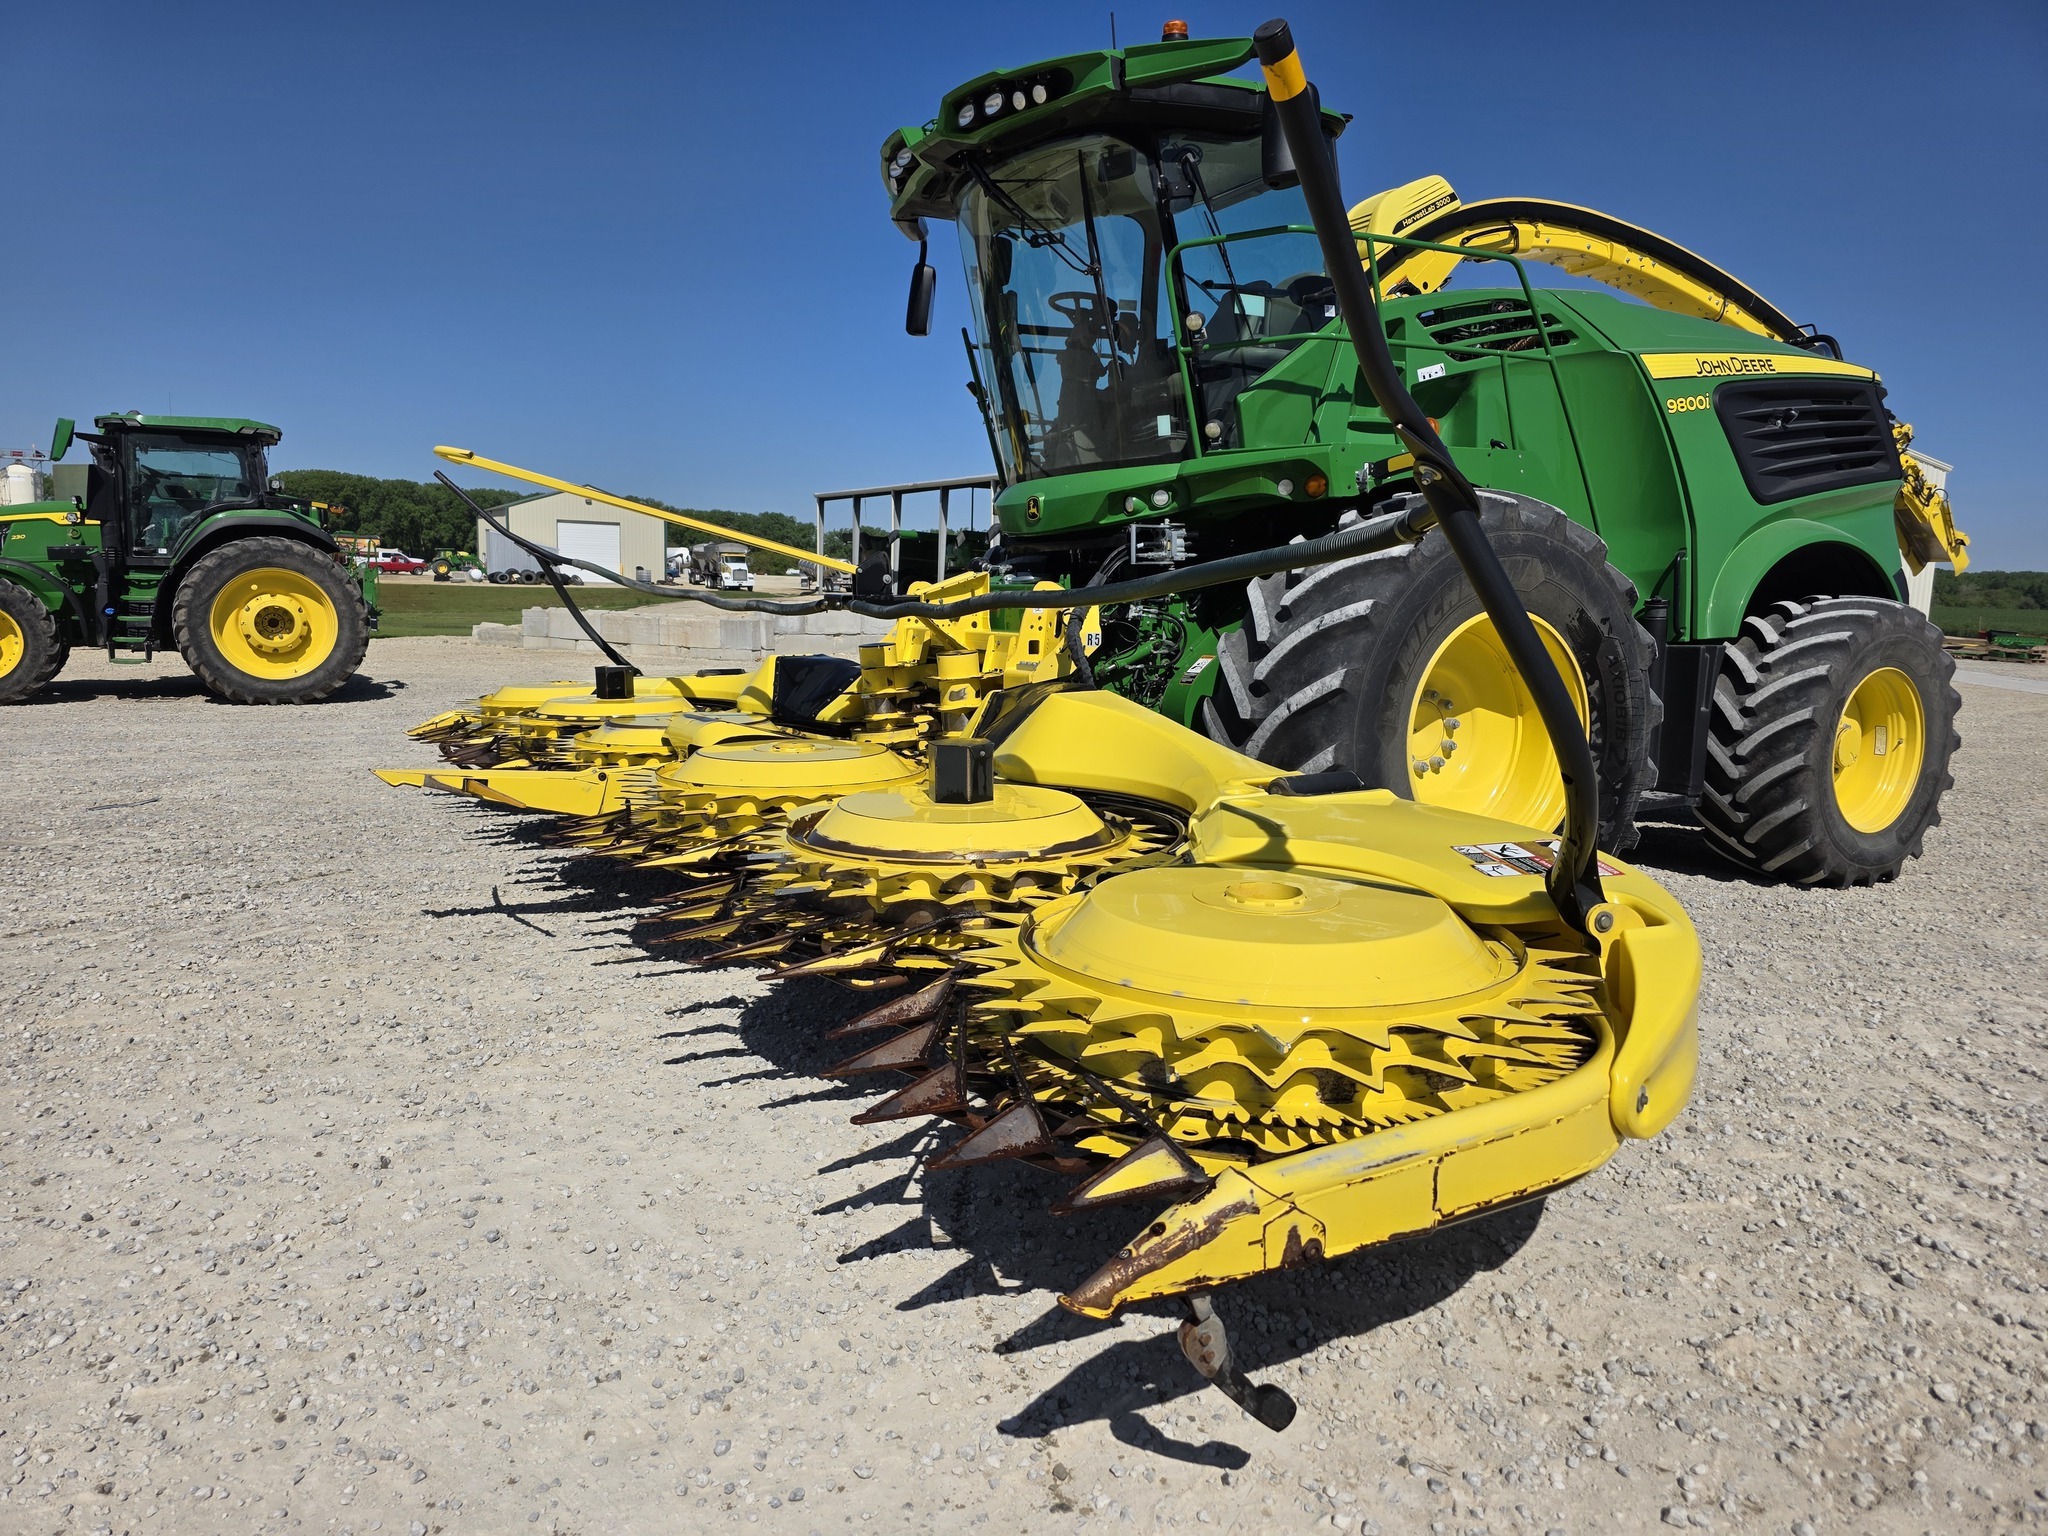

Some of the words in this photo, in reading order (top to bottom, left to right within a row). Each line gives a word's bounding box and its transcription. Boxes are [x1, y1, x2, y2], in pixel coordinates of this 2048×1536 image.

[1402, 205, 1436, 227] HarvestLab
[1435, 196, 1451, 209] 3000
[1666, 392, 1710, 414] 9800i
